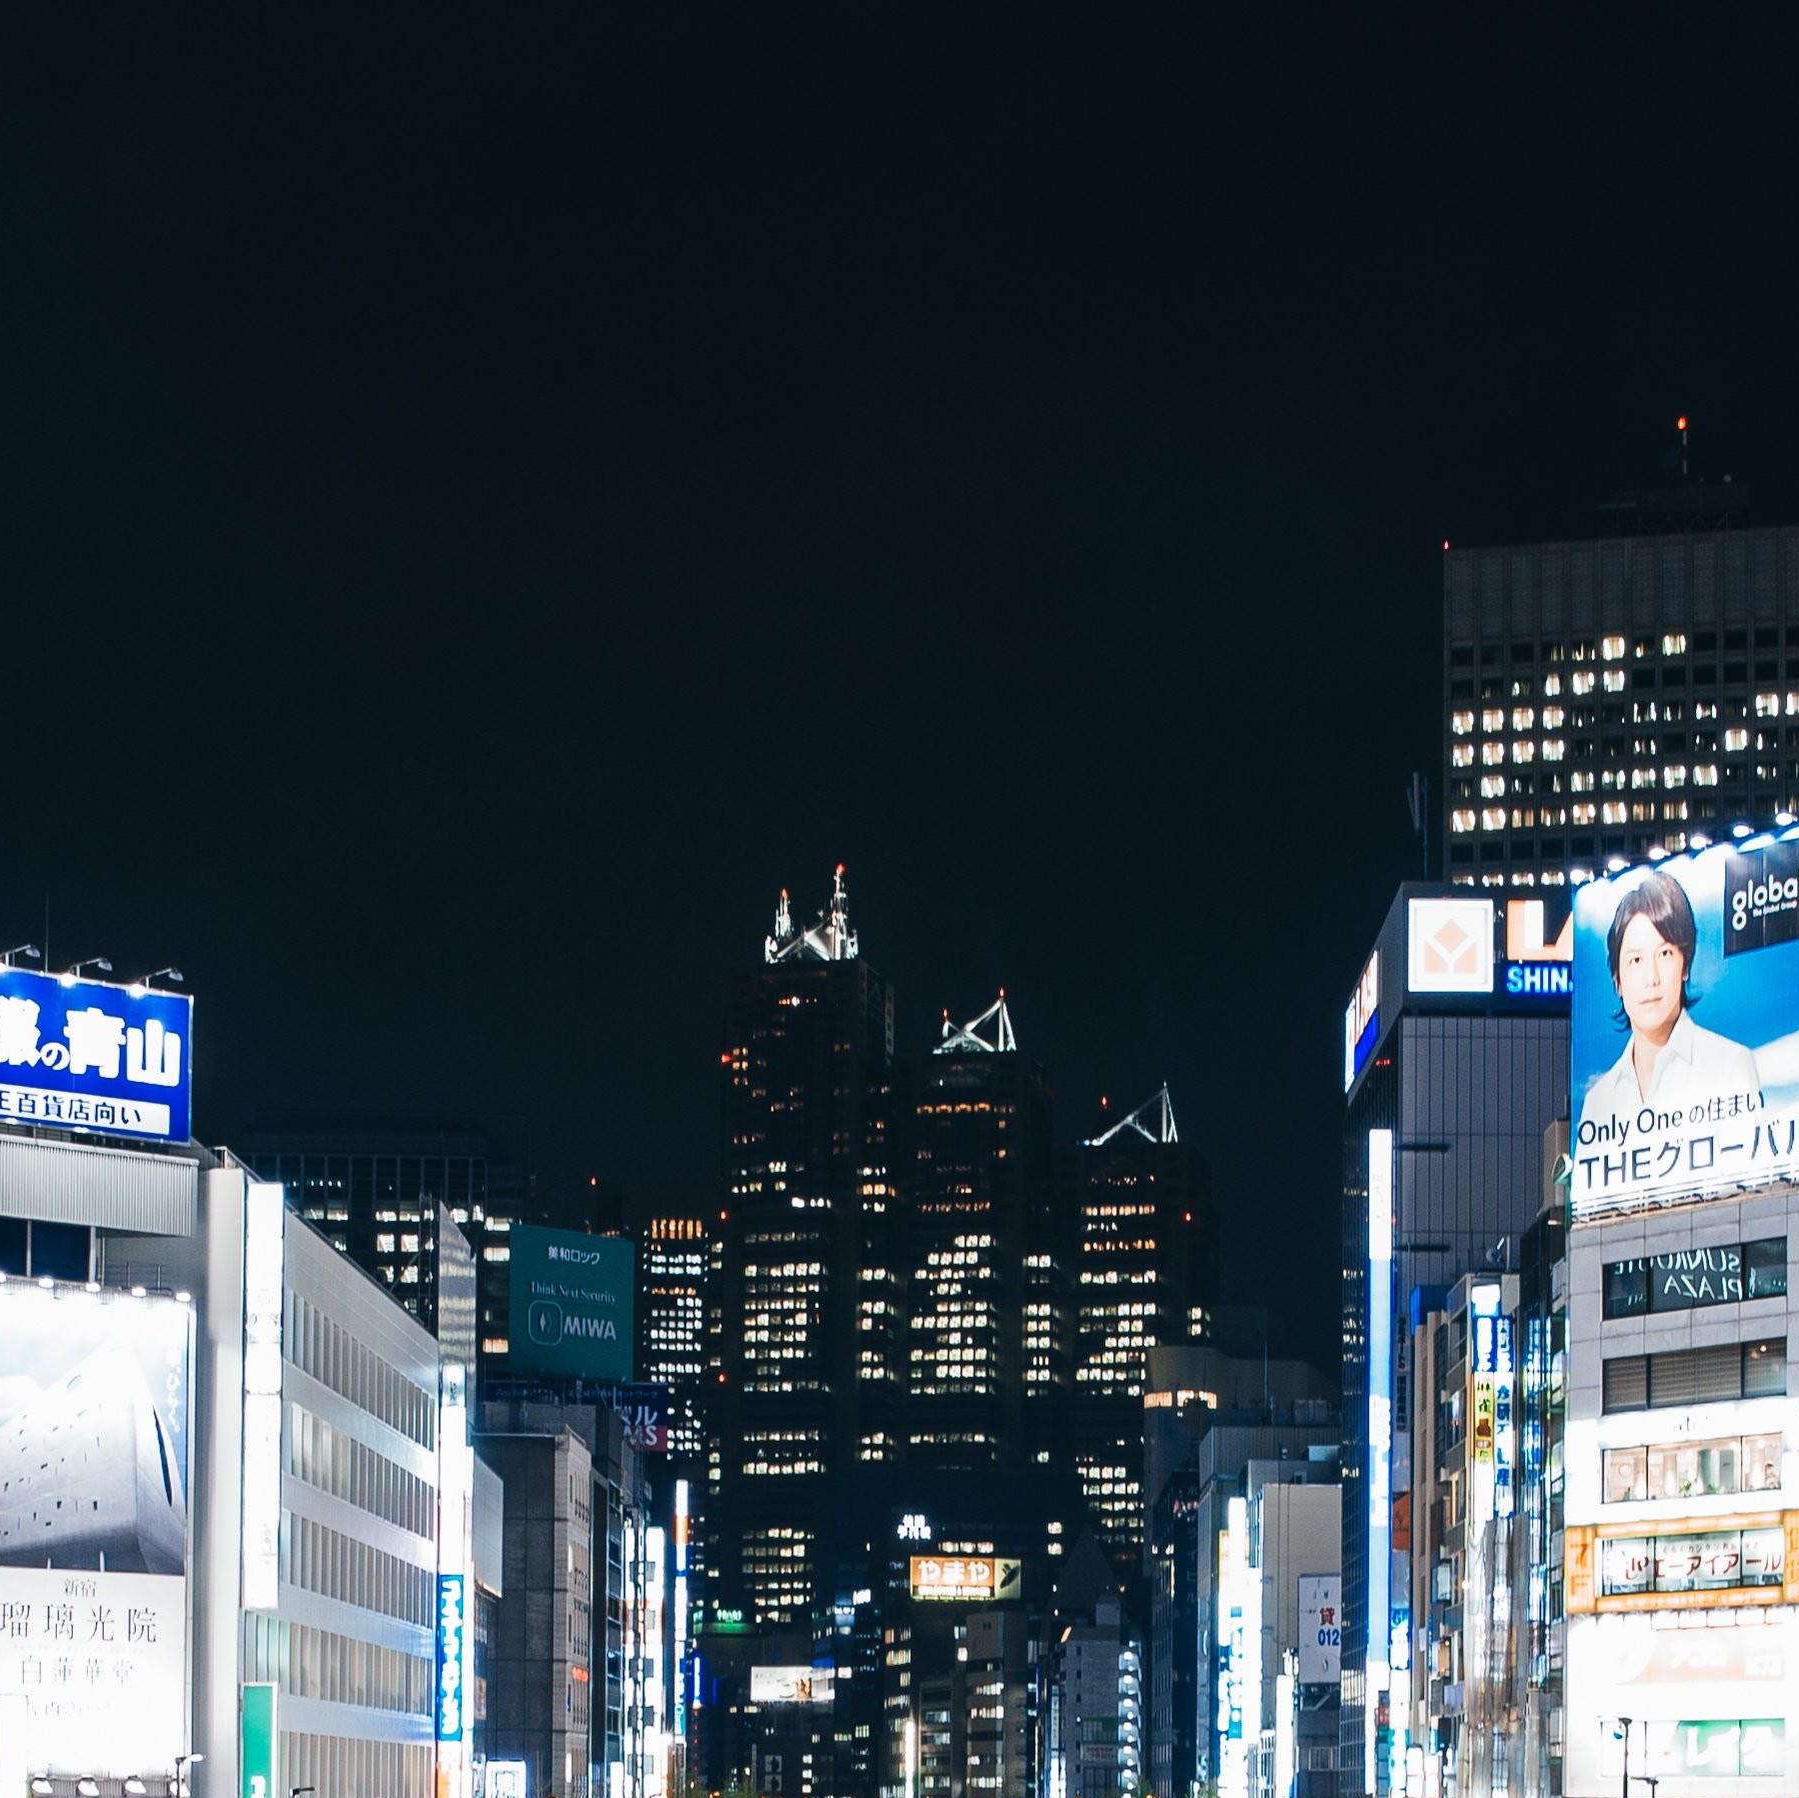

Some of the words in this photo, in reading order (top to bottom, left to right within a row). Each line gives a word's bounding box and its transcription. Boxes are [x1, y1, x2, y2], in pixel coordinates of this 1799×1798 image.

[1507, 966, 1573, 994] SHIN
[1578, 1114, 1630, 1148] Only
[1637, 1109, 1684, 1135] One
[1688, 1090, 1765, 1125] の住まい
[548, 1246, 601, 1265] 美和ロック
[531, 1281, 556, 1296] Think
[558, 1284, 579, 1299] Next
[580, 1288, 617, 1306] Security
[564, 1315, 617, 1341] MIWA
[917, 1559, 990, 1586] やまや
[63, 1577, 97, 1598] 新宿
